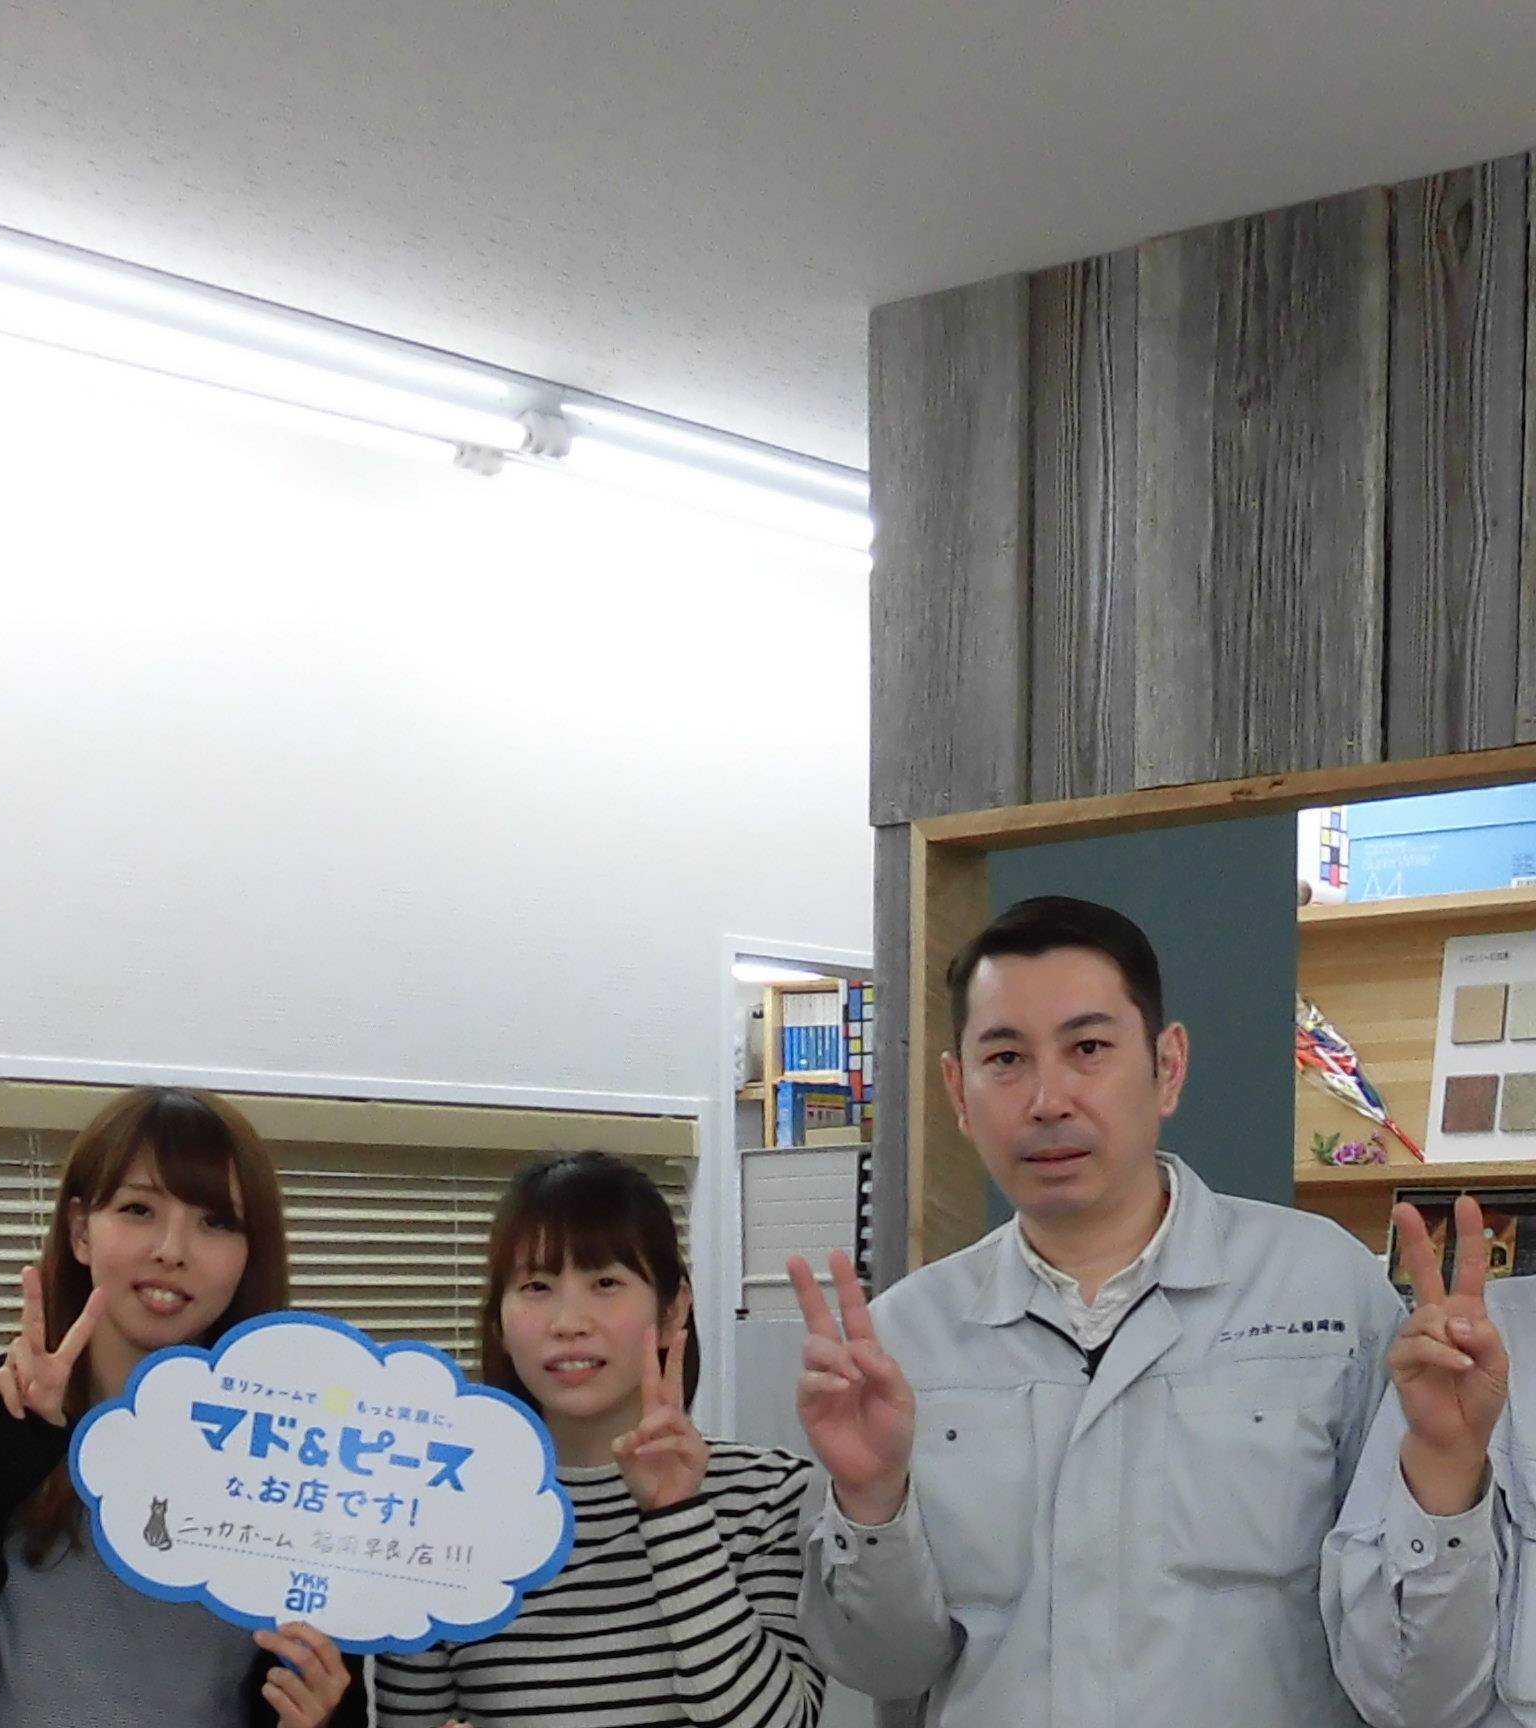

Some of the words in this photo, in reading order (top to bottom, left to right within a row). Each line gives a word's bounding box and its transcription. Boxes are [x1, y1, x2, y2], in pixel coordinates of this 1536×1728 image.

[190, 1401, 476, 1492] マド&ピース
[289, 1571, 330, 1592] YKK
